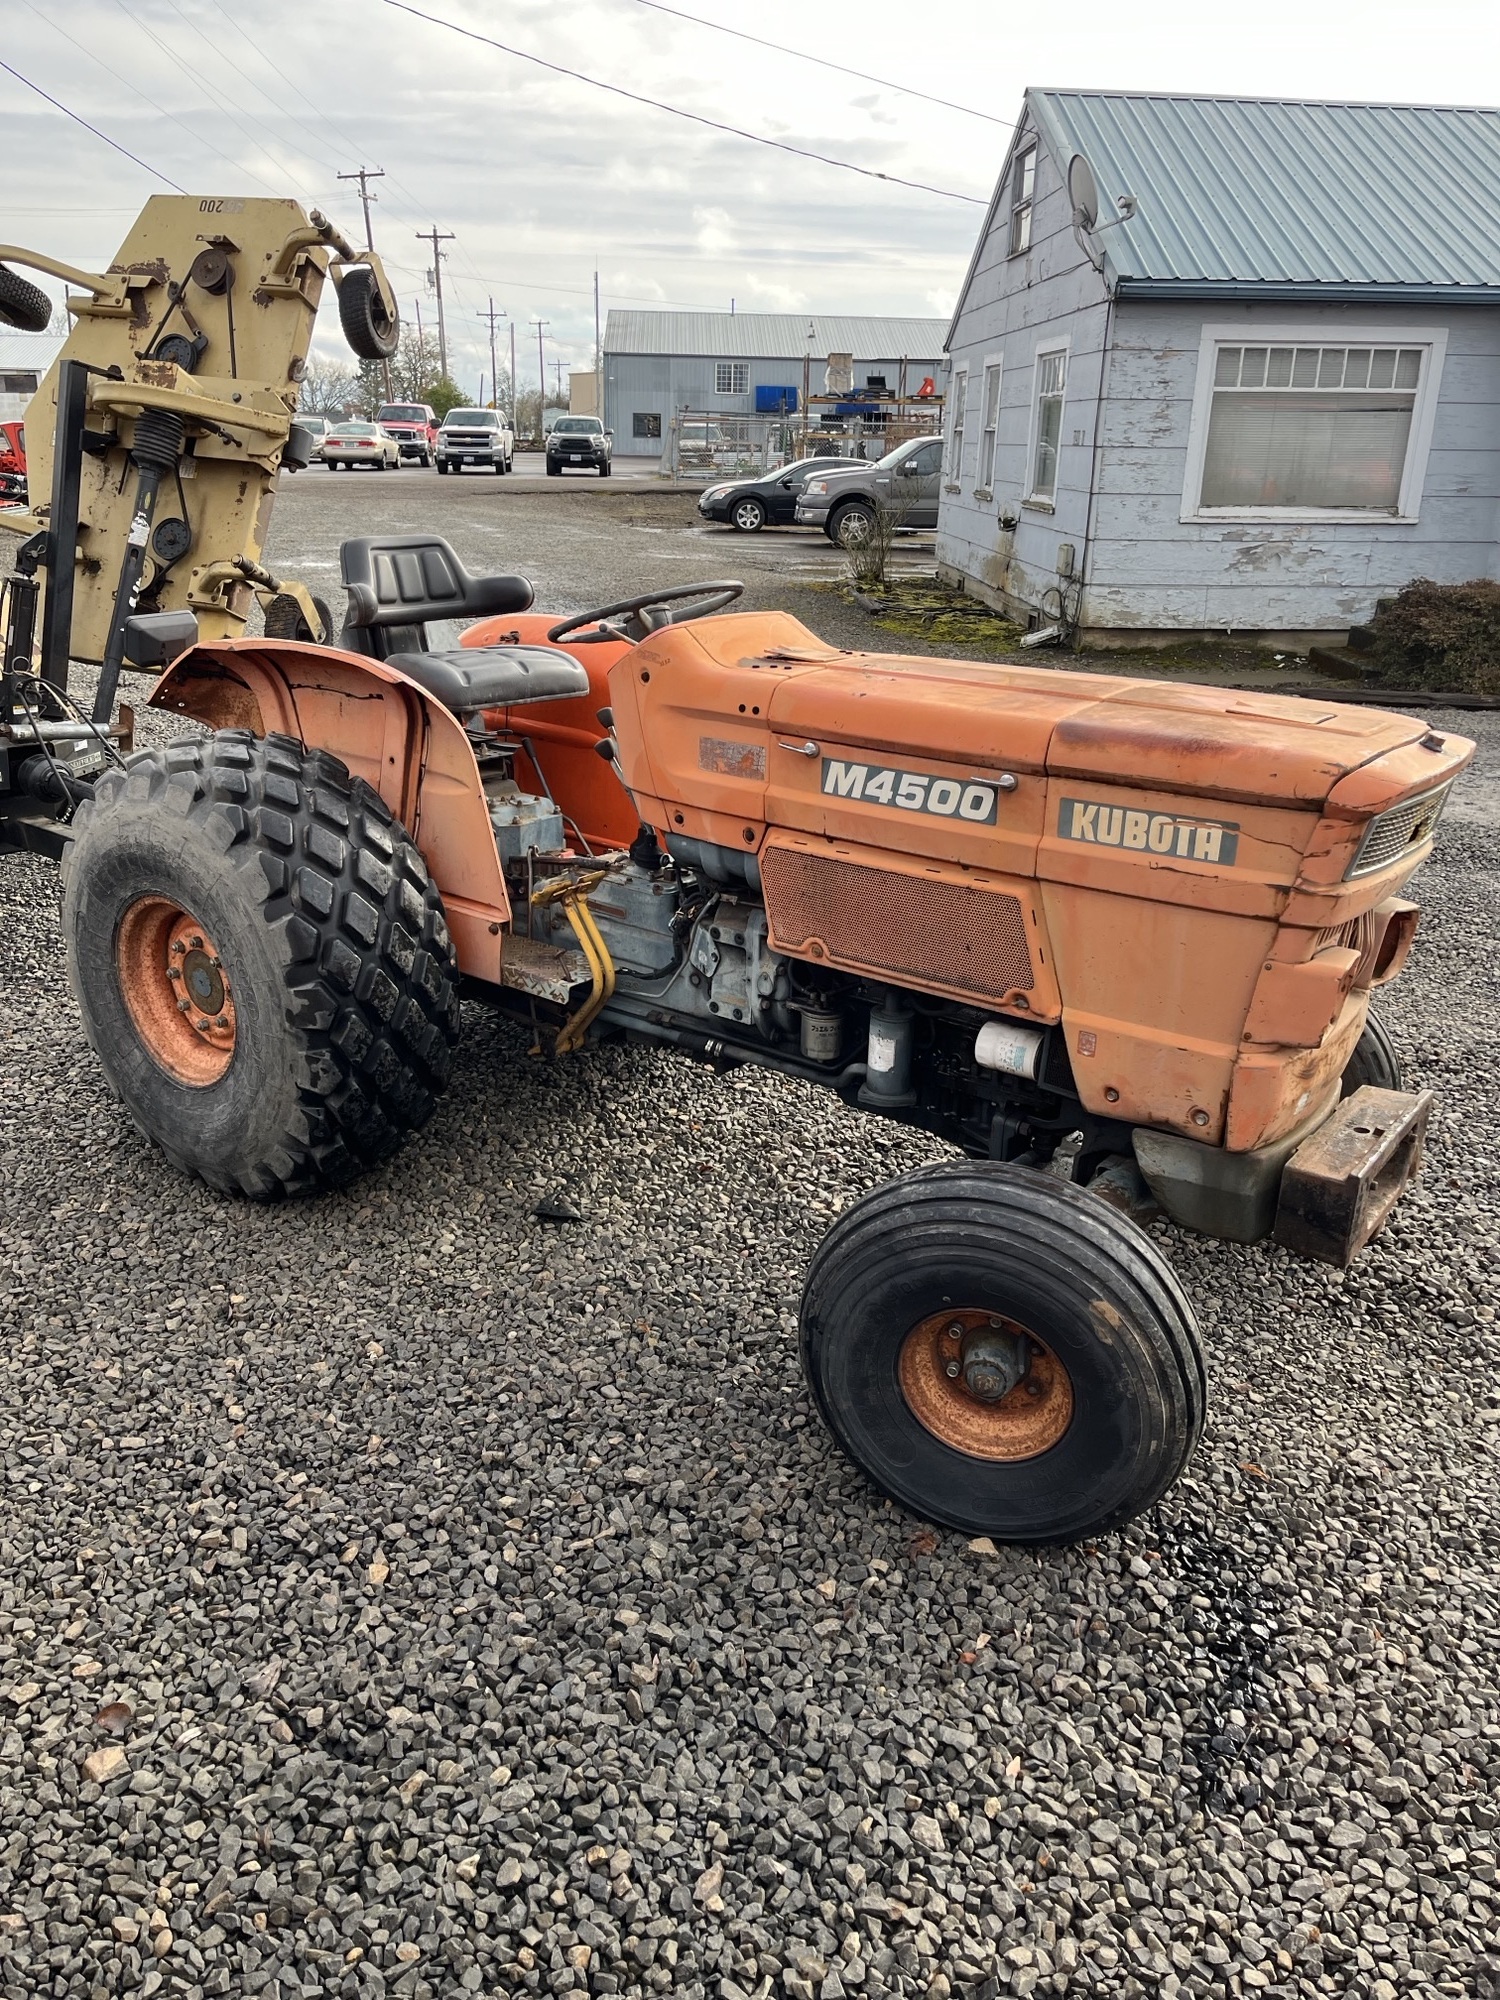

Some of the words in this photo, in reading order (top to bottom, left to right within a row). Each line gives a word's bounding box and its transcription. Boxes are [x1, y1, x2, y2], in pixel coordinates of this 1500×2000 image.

[199, 199, 224, 213] 200
[824, 761, 995, 821] M4500
[1070, 802, 1223, 862] KUBOTA
